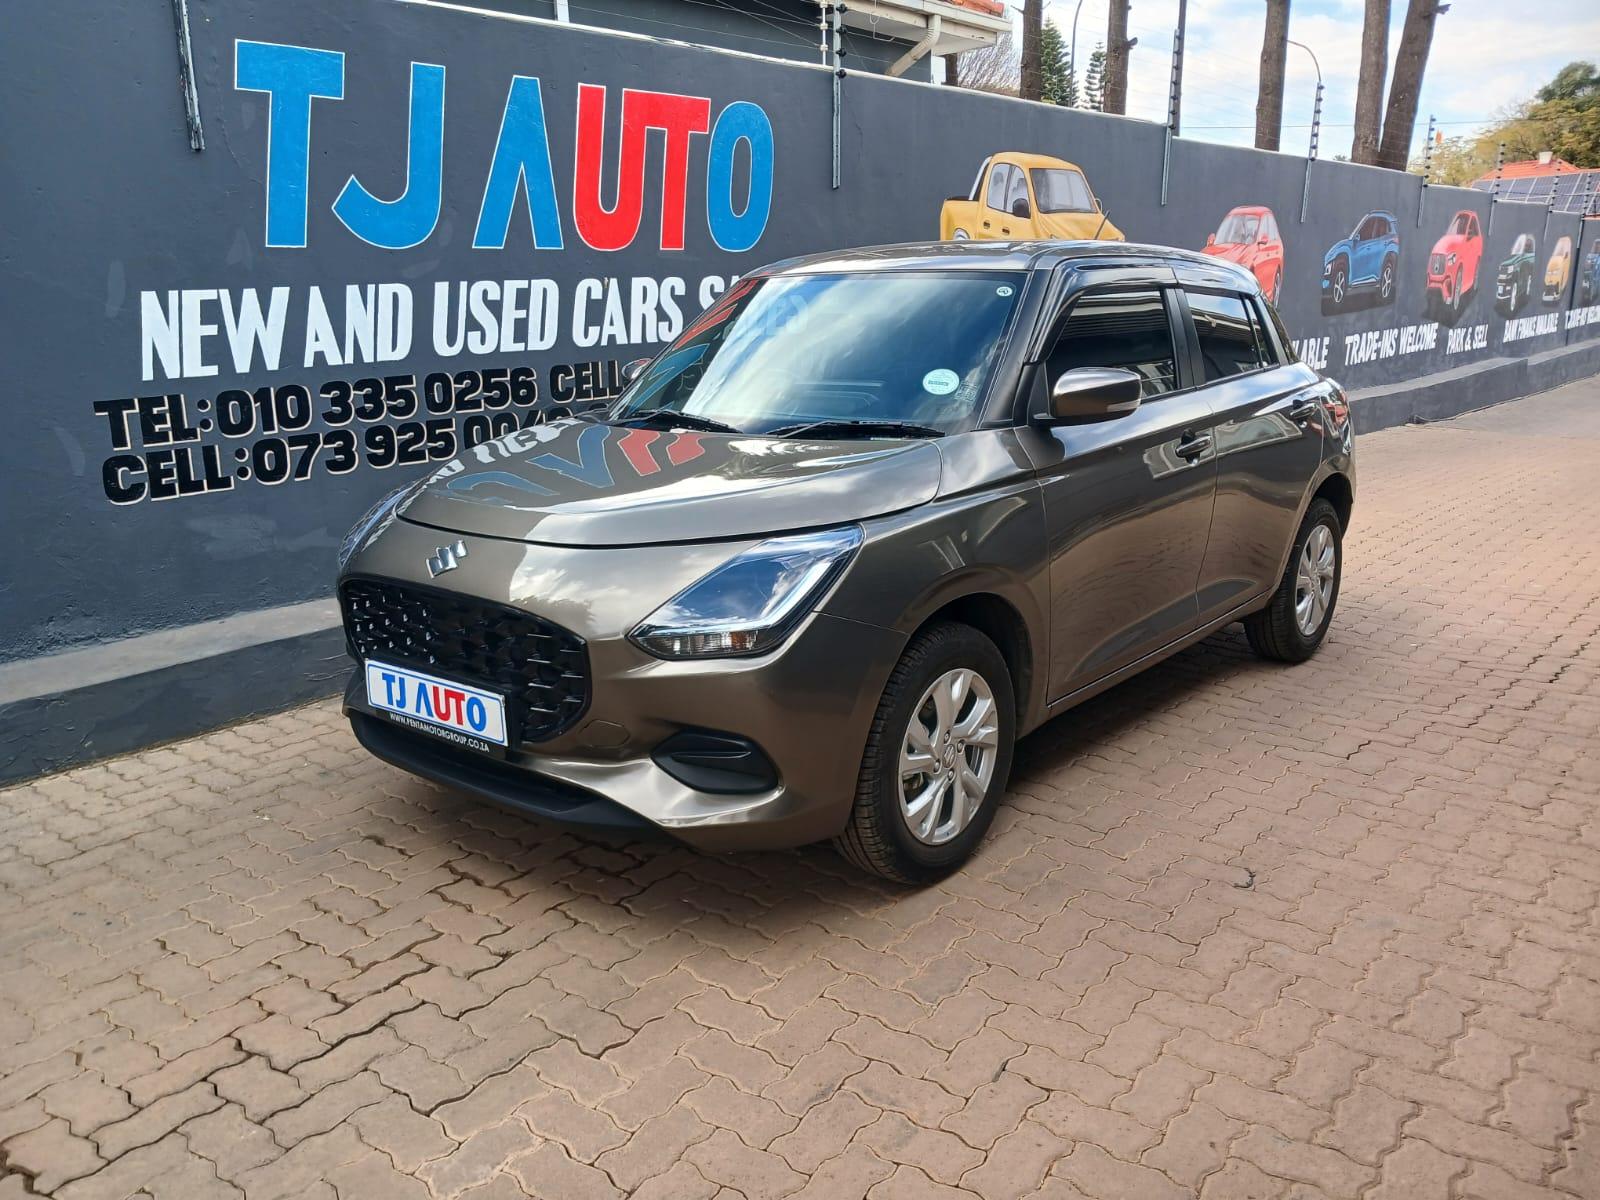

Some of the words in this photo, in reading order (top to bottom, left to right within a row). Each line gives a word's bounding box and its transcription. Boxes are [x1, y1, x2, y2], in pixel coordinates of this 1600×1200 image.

[234, 38, 446, 250] TJ
[471, 74, 775, 252] AUTO
[141, 286, 290, 381] NEW
[304, 283, 413, 368] AND
[432, 278, 560, 357] USED
[572, 276, 686, 348] CARS
[1344, 328, 1399, 366] TRADE-INS
[1398, 322, 1440, 354] WELCOME
[1446, 328, 1467, 355] PARK
[1464, 326, 1473, 352] &
[1472, 324, 1489, 349] SELL
[319, 374, 418, 427] 335
[424, 367, 538, 415] 0256
[364, 418, 458, 468] 925
[382, 672, 406, 709] TJ
[415, 683, 487, 732] AUTO
